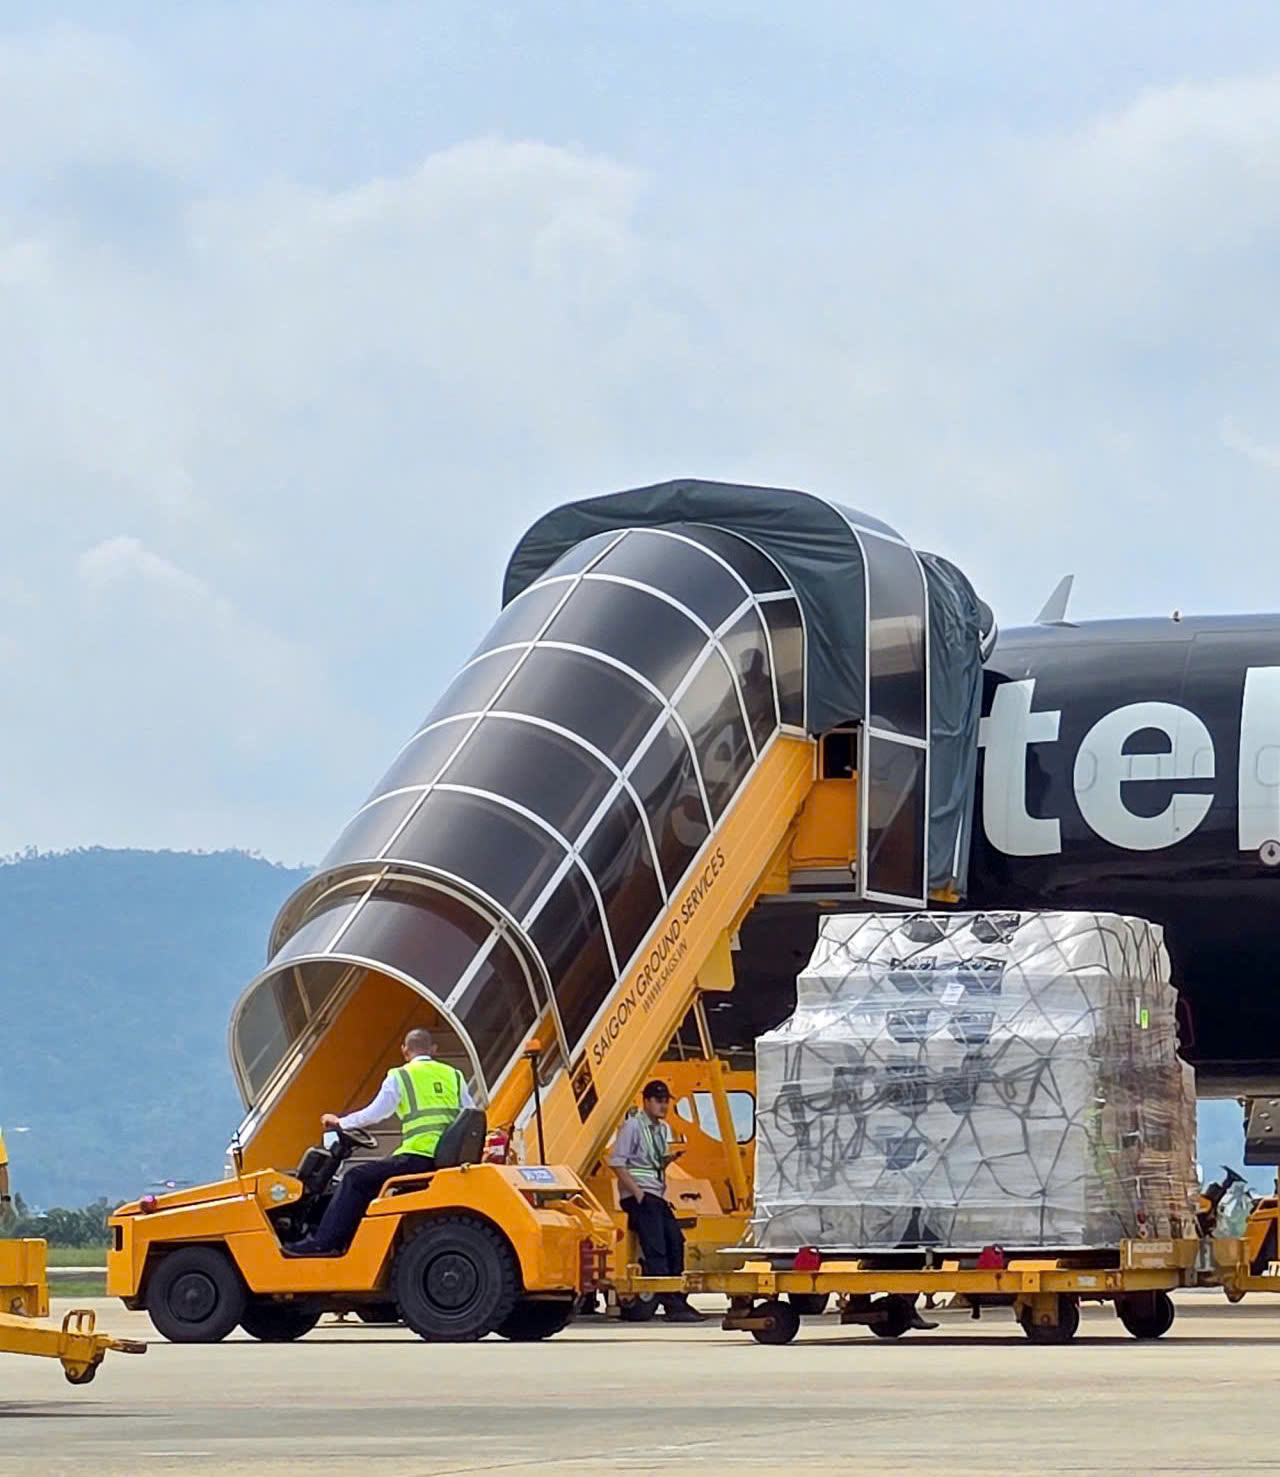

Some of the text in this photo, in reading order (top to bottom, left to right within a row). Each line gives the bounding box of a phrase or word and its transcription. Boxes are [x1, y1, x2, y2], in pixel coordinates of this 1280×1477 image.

[593, 847, 726, 1066] SAIGON GROUND SERVICES
